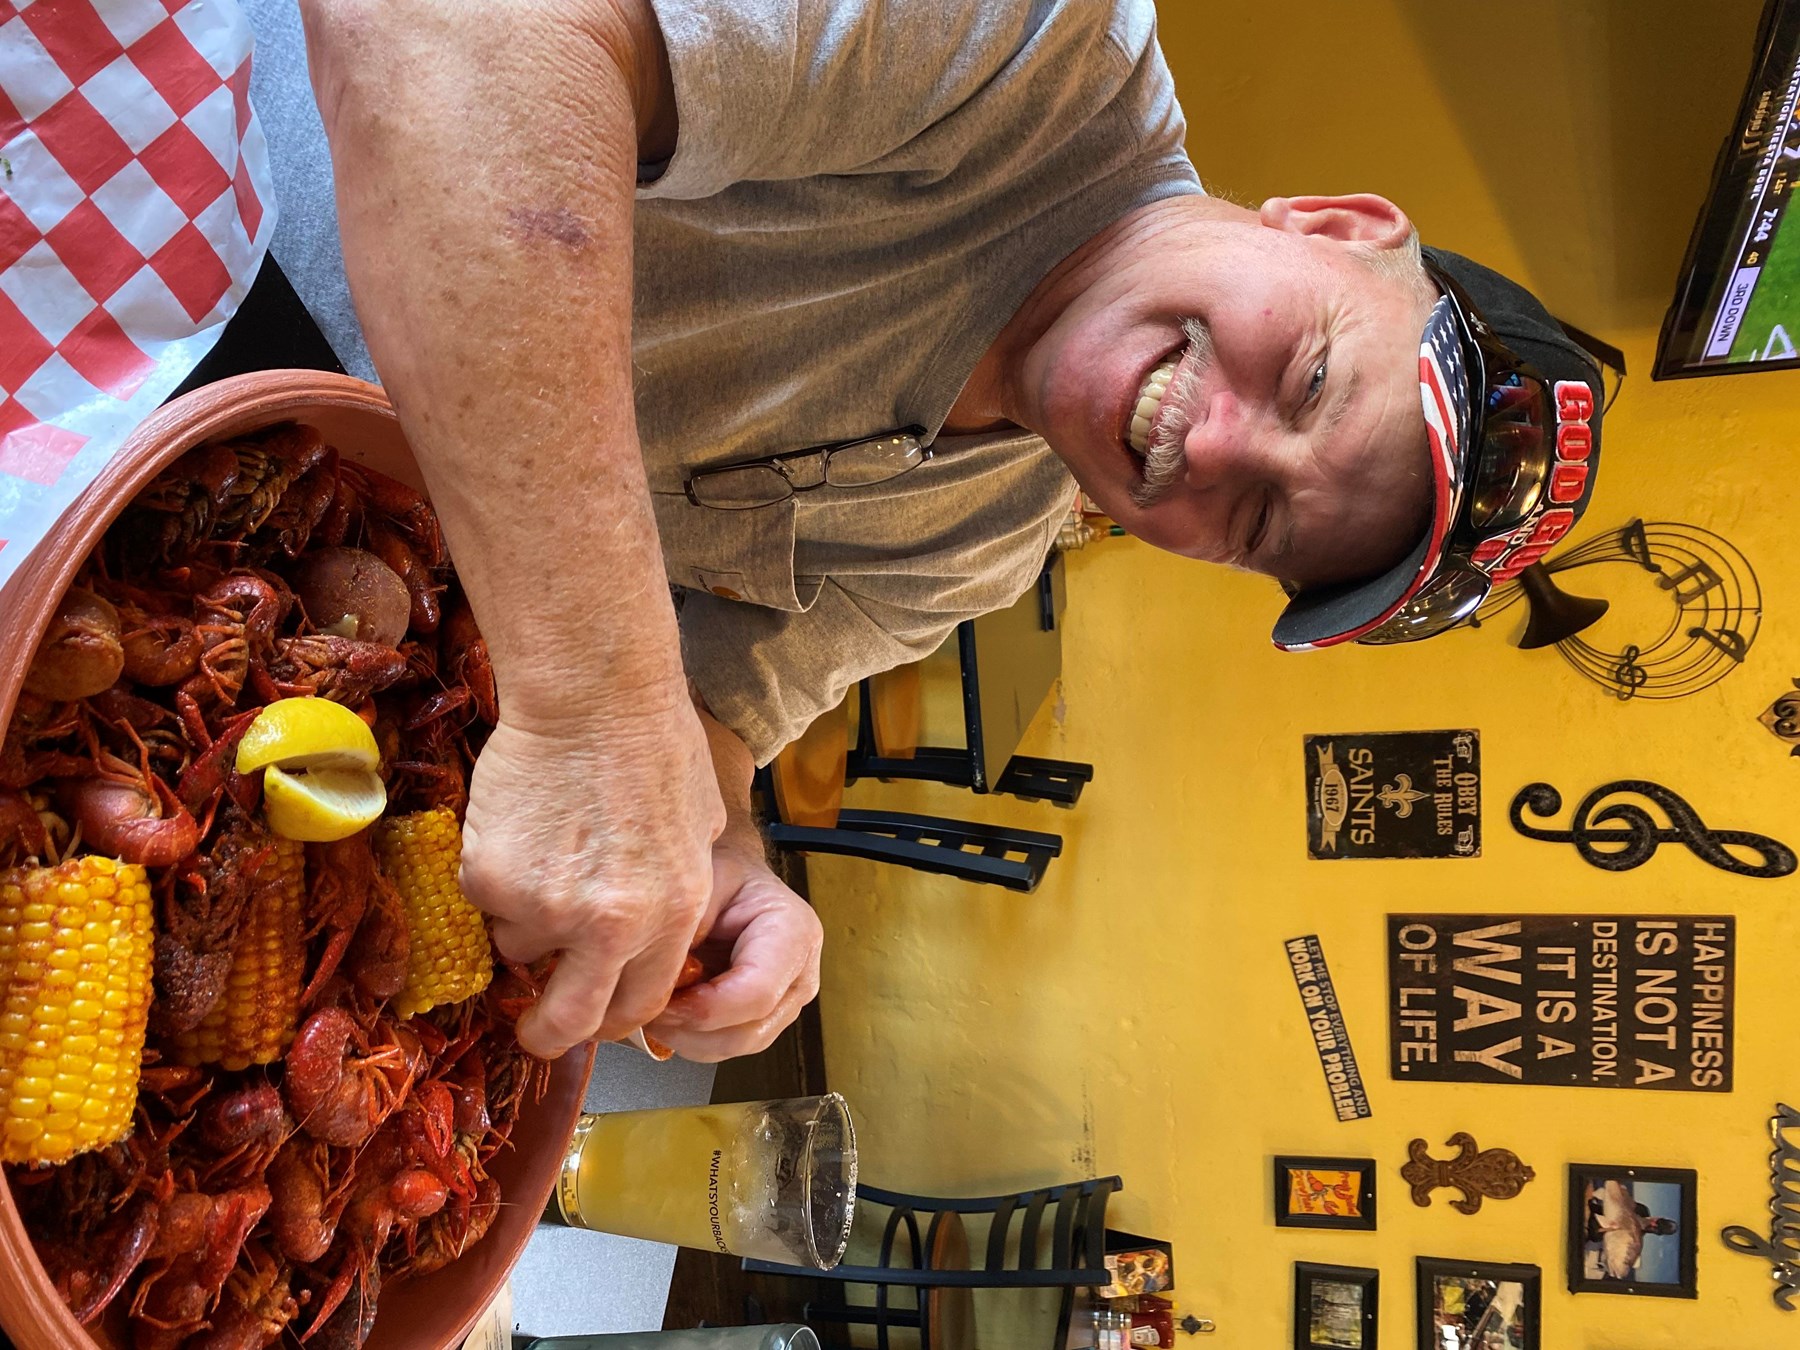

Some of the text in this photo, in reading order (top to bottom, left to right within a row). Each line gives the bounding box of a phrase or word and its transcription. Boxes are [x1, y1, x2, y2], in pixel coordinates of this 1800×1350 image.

[1750, 169, 1769, 200] BOWL
[1762, 125, 1783, 165] FIESTA
[1772, 178, 1787, 195] 1ST
[1753, 208, 1779, 243] 7:44
[1716, 283, 1749, 342] 3RD DOWN
[1548, 380, 1594, 503] GOD
[1324, 783, 1339, 813] 1967
[1348, 748, 1375, 845] SAINTS
[1433, 754, 1454, 835] THE RULES
[1454, 772, 1479, 816] OBEY
[1286, 938, 1359, 1121] WORK ON YOUR PROBLEM
[1306, 939, 1369, 1115] LET ME STOP EVERYTHING AND
[1398, 923, 1438, 1072] OF LIFE.
[1452, 920, 1522, 1080] WAY
[1536, 946, 1577, 1060] IT IS A
[1592, 921, 1619, 1082] DESTINATION.
[1634, 920, 1678, 1085] IS NOT A
[1690, 922, 1726, 1087] HAPPINESS
